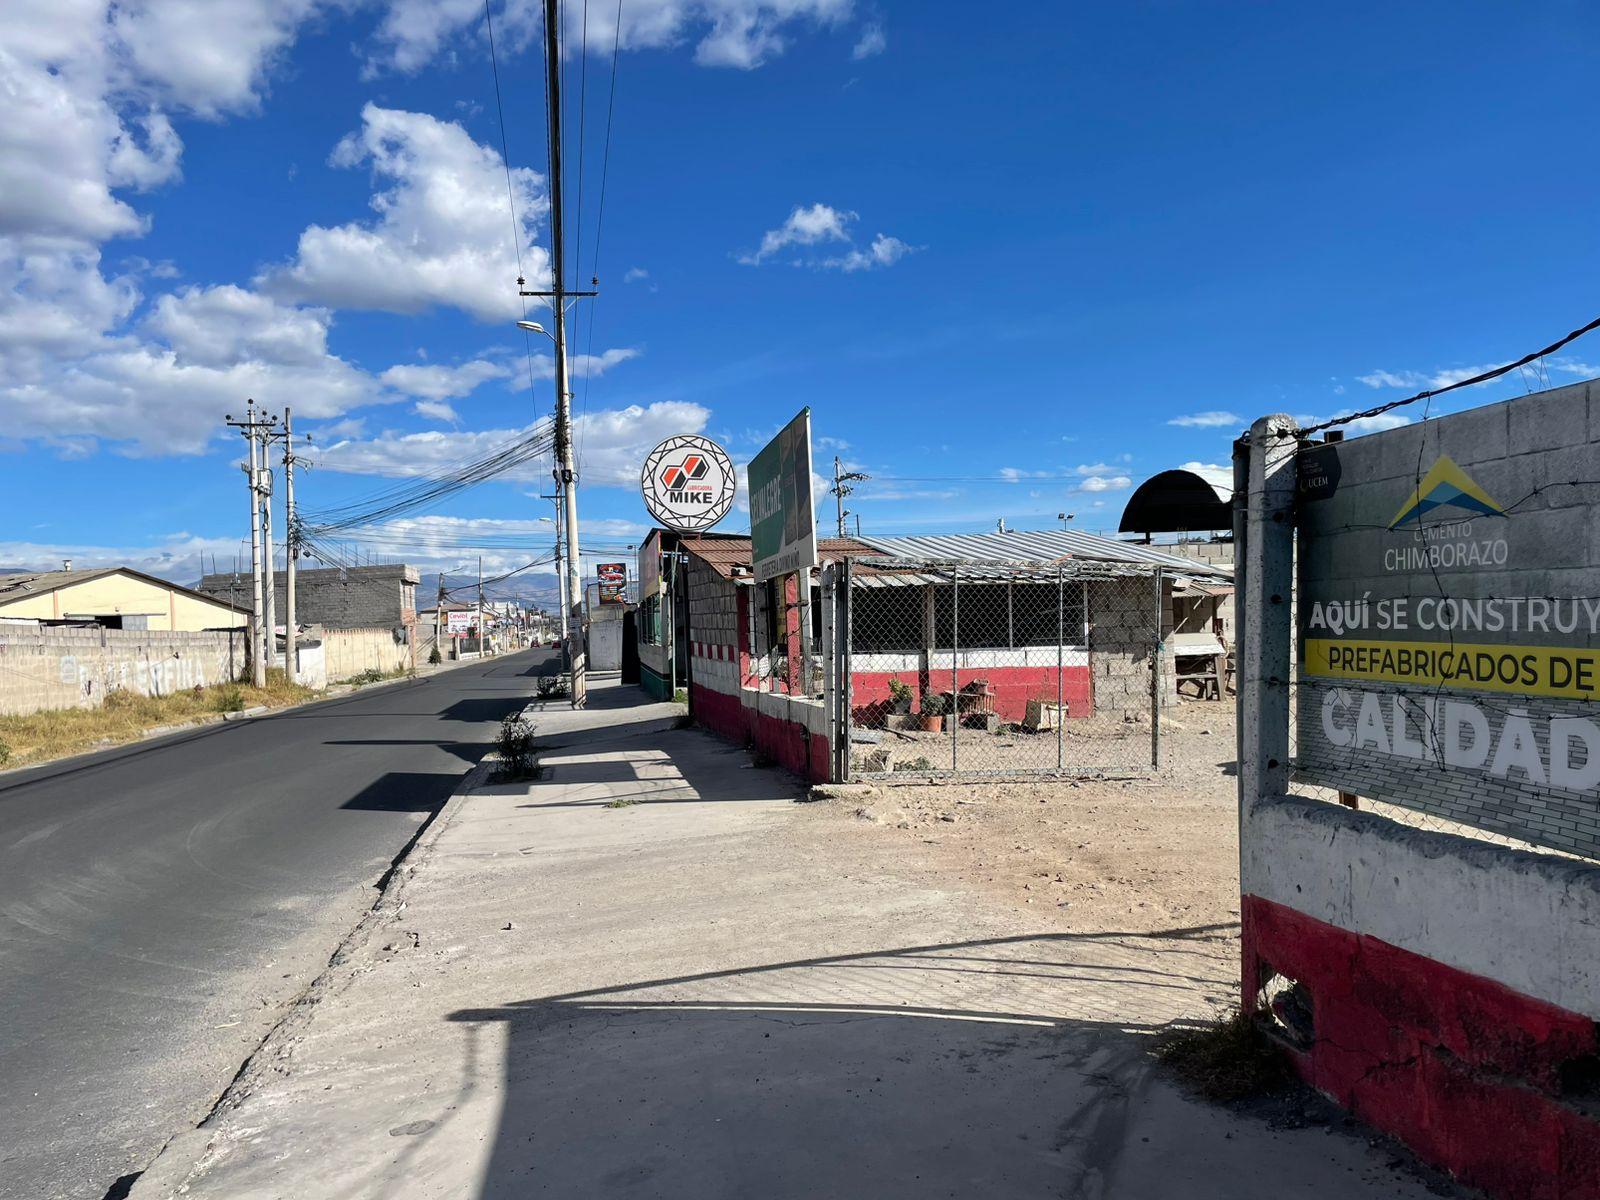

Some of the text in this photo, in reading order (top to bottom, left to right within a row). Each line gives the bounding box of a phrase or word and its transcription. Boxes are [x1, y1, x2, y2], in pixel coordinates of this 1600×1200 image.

[669, 491, 713, 504] MIKE
[1308, 475, 1329, 489] UCEM
[1414, 521, 1472, 543] CEMENTO
[1384, 539, 1509, 571] CHIMBORAZO
[1309, 591, 1371, 635] AQUÍ
[1376, 599, 1408, 630] SE
[1329, 646, 1595, 691] PREFABRICADOS DE
[1321, 687, 1600, 790] CALIDAD
